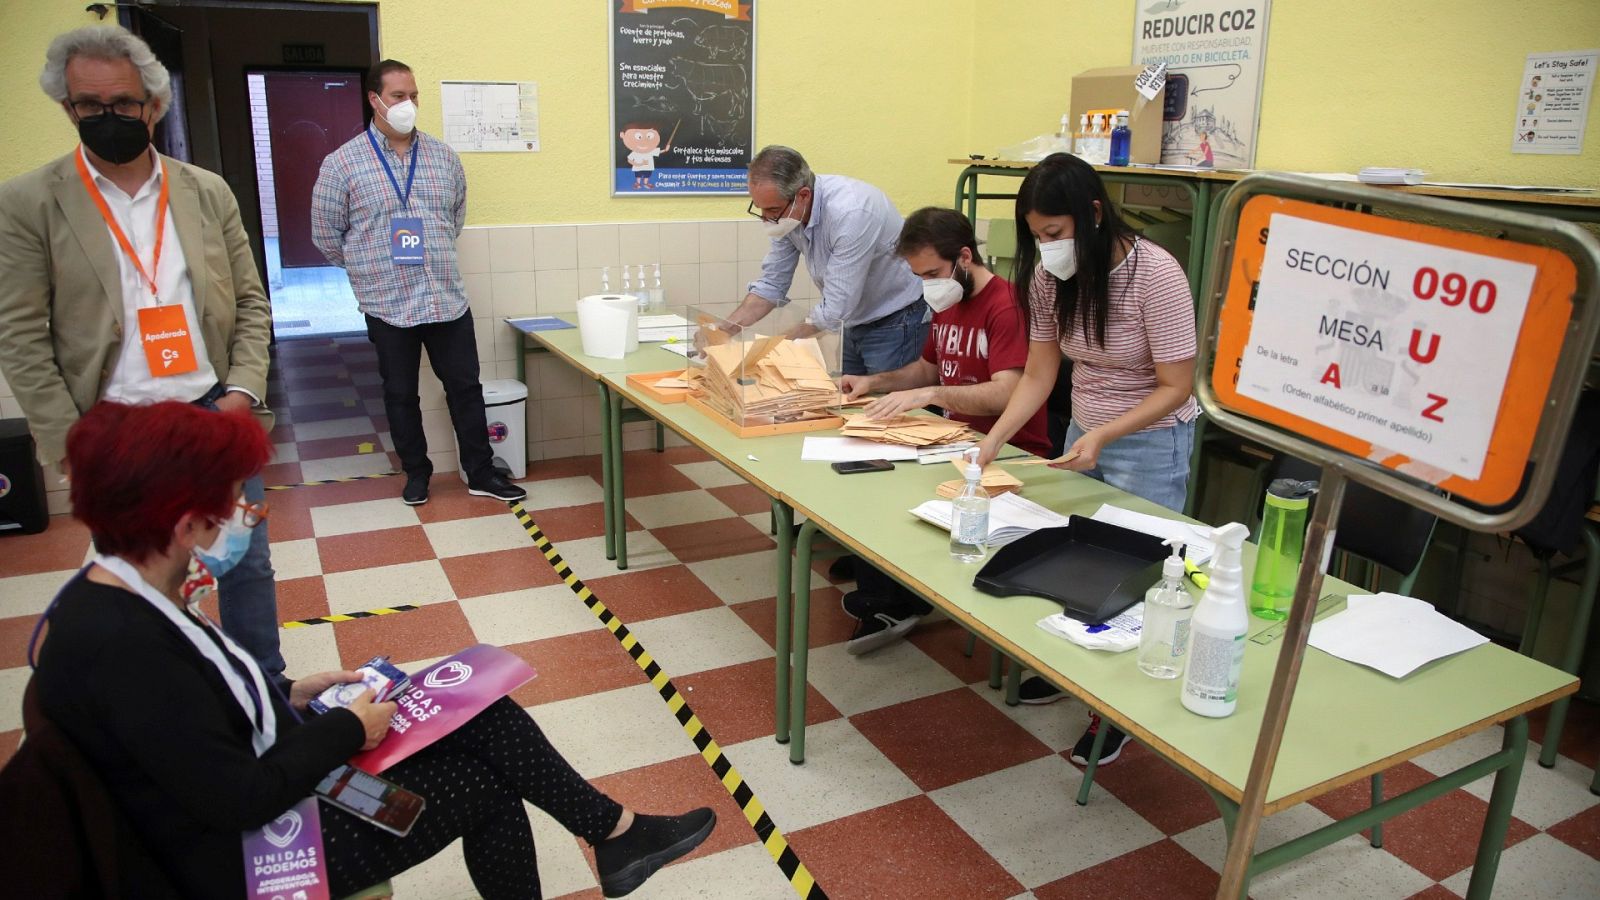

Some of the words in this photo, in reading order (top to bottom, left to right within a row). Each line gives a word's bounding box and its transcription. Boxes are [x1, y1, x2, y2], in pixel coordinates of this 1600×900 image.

[1143, 13, 1214, 39] REDUCIR
[1219, 8, 1256, 32] CO2
[1142, 54, 1180, 65] ANDANDO
[1190, 53, 1202, 63] EN
[1534, 61, 1550, 69] Let's
[1552, 60, 1567, 69] Stay
[1569, 58, 1588, 67] Safe!
[620, 62, 631, 71] Son
[632, 64, 666, 72] esenciales
[622, 72, 637, 80] para
[638, 73, 664, 82] nuestro
[1135, 70, 1152, 89] 2021
[623, 81, 663, 90] crecimiento
[685, 155, 690, 164] y
[691, 155, 702, 164] tus
[704, 147, 715, 157] tus
[1285, 247, 1390, 290] SECCIÓN
[1412, 266, 1497, 314] 090
[145, 328, 187, 343] Apoderado
[1319, 315, 1384, 351] MESA
[1408, 328, 1441, 364] U
[161, 348, 180, 360] Cs
[1256, 344, 1269, 357] De
[1270, 348, 1279, 360] la
[1279, 351, 1298, 367] letra
[1320, 362, 1341, 389] A
[1371, 384, 1379, 393] a
[1380, 384, 1390, 396] la
[1420, 392, 1449, 423] Z
[1281, 382, 1313, 405] (Orden
[1313, 392, 1357, 416] alfabético
[1356, 405, 1389, 427] primer
[1389, 413, 1433, 443] apellido)
[253, 846, 316, 866] UNIDAS
[254, 857, 318, 877] PODEMOS
